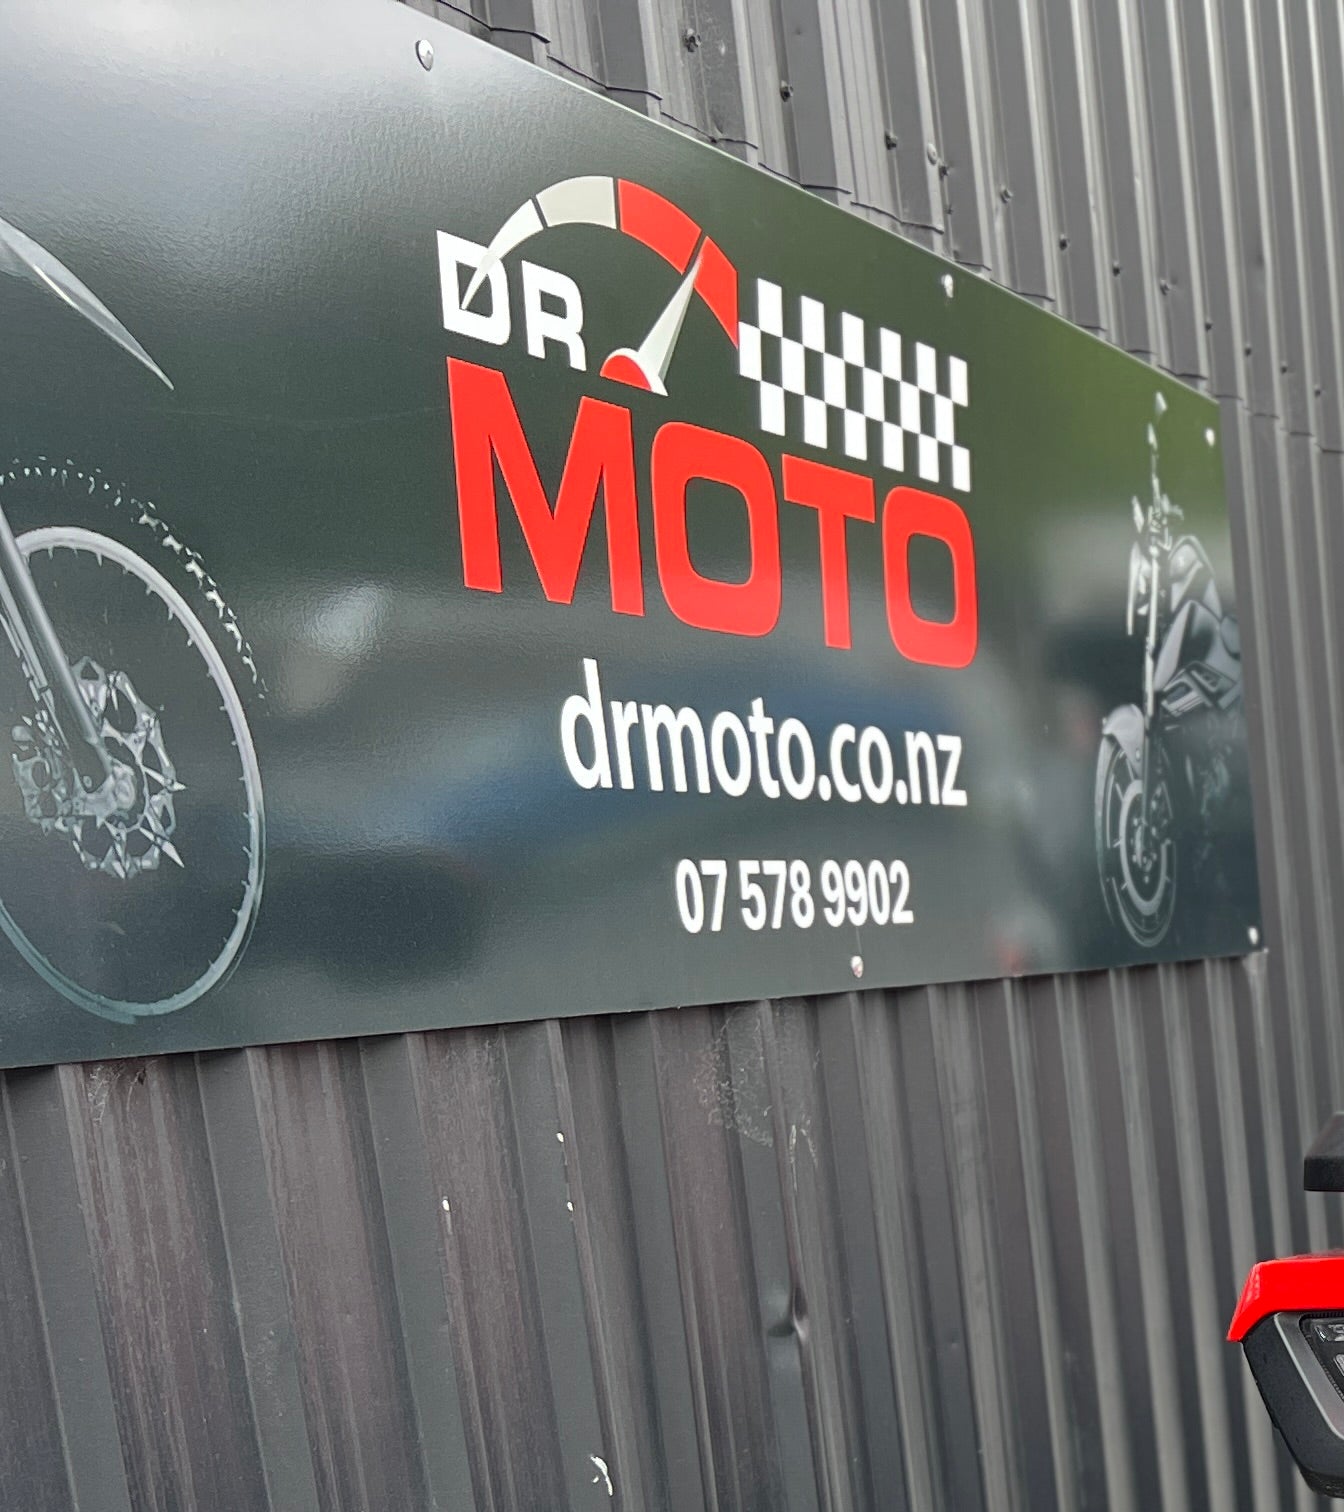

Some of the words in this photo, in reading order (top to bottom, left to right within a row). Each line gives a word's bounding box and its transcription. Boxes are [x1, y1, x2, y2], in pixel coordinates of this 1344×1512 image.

[436, 230, 587, 371] DR
[447, 356, 978, 669] MOTO
[560, 657, 967, 806] drmoto.co.nz
[676, 858, 727, 934] 07
[738, 859, 815, 931] 578
[821, 859, 914, 927] 9902
